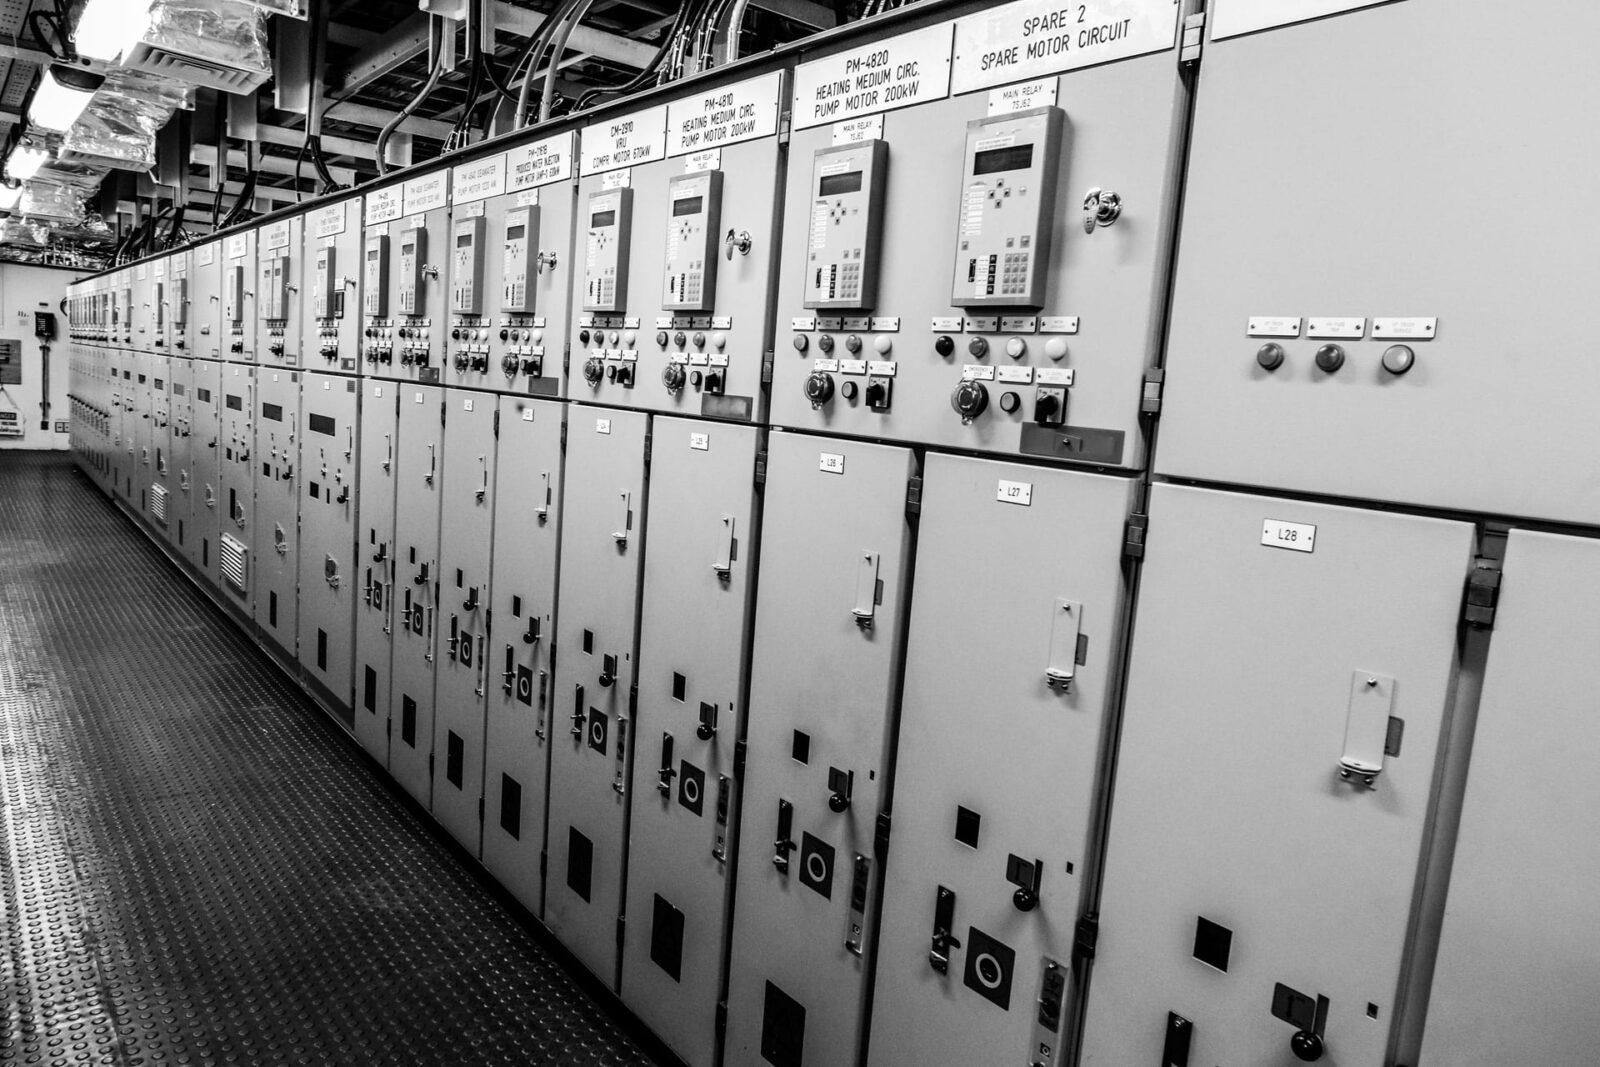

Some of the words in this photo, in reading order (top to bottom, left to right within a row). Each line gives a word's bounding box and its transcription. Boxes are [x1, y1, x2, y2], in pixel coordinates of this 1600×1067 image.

[1023, 9, 1068, 37] SPARE
[1077, 4, 1086, 24] 2
[981, 46, 1019, 71] SPARE
[1027, 34, 1070, 59] MOTOR
[1078, 18, 1131, 49] CIRCUIT
[846, 49, 889, 74] PM-4820
[816, 79, 850, 100] HEATING
[855, 67, 891, 90] MEDIUM
[896, 61, 920, 81] CIRC.
[1002, 89, 1019, 100] MAIN
[1022, 83, 1043, 96] RELAY
[704, 92, 734, 112] PM-4810
[814, 99, 840, 119] PUMP
[845, 90, 878, 111] MOTOR
[884, 80, 920, 103] 200kW
[682, 115, 708, 133] HEATING
[710, 107, 736, 126] MEDIUM
[843, 124, 855, 132] MAIN
[857, 120, 873, 130] RELAY
[615, 136, 628, 150] VRU
[681, 132, 700, 148] PUMP
[703, 126, 727, 143] MOTOR
[730, 119, 756, 137] 200kW
[613, 149, 631, 163] MOTOR
[1007, 486, 1021, 497] L27
[1278, 528, 1298, 542] L28
